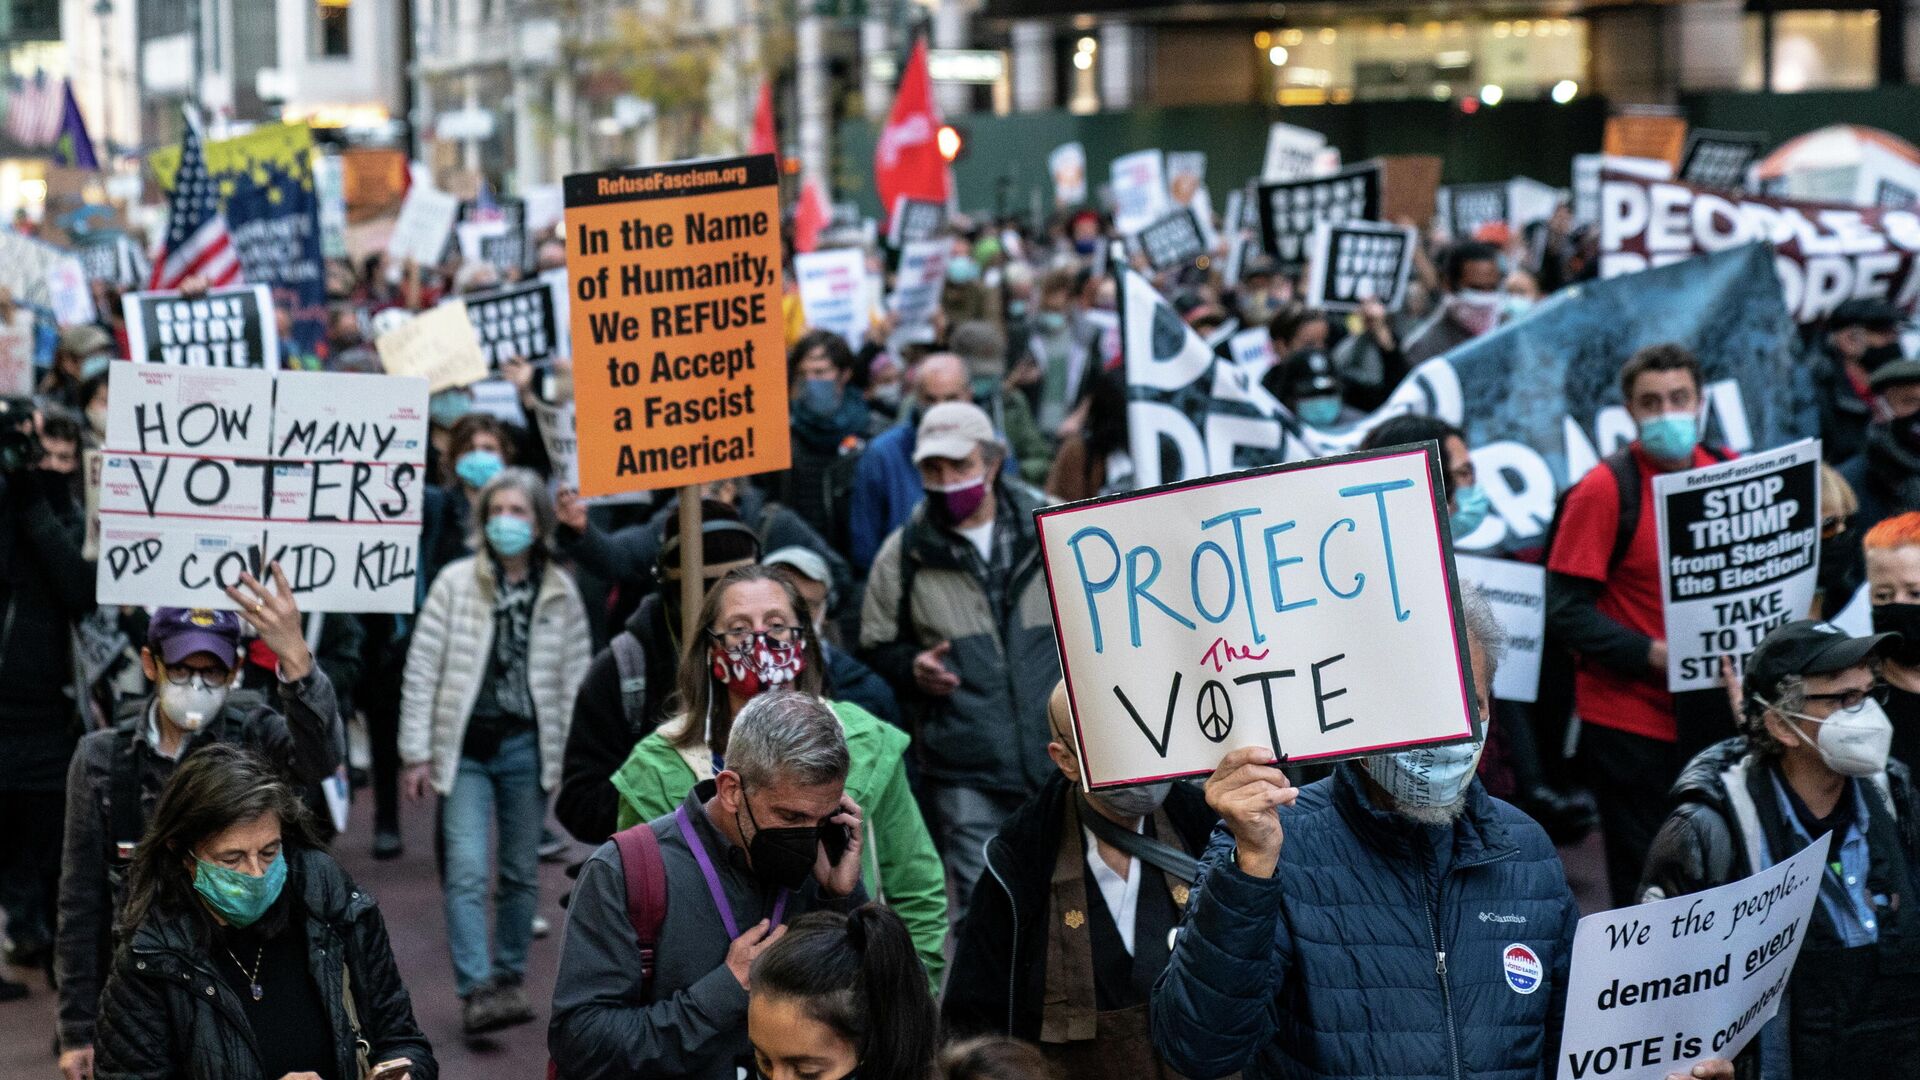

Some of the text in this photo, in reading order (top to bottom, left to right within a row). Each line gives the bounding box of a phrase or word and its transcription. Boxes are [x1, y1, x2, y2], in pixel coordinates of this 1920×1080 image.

[598, 167, 748, 196] RefuseFascism.org
[578, 210, 769, 257] In the Name
[576, 266, 609, 302] of
[620, 251, 776, 297] Humanity,
[588, 311, 640, 345] We
[651, 293, 768, 339] REFUSE
[607, 340, 756, 389] to Accept
[134, 402, 397, 461] HOW MANY
[612, 384, 756, 432] a Fascist
[615, 427, 756, 478] America!
[1686, 452, 1798, 488] RefuseFascism.org
[129, 455, 417, 524] VOTERS
[1702, 474, 1784, 520] STOP
[1687, 498, 1799, 550] TRUMP
[106, 538, 163, 581] DID
[354, 540, 416, 592] KILL
[1066, 478, 1415, 655] PROTECT
[1671, 525, 1816, 577] from Stealing
[1676, 542, 1812, 597] the Election!
[1713, 589, 1784, 627] TAKE
[1200, 637, 1270, 673] The
[1699, 627, 1738, 653] TO
[1112, 653, 1355, 764] VOTE
[1605, 861, 1811, 952] We the people...
[1597, 916, 1802, 1011] demand every
[1568, 1035, 1665, 1080] VOTE
[1672, 1031, 1703, 1062] is
